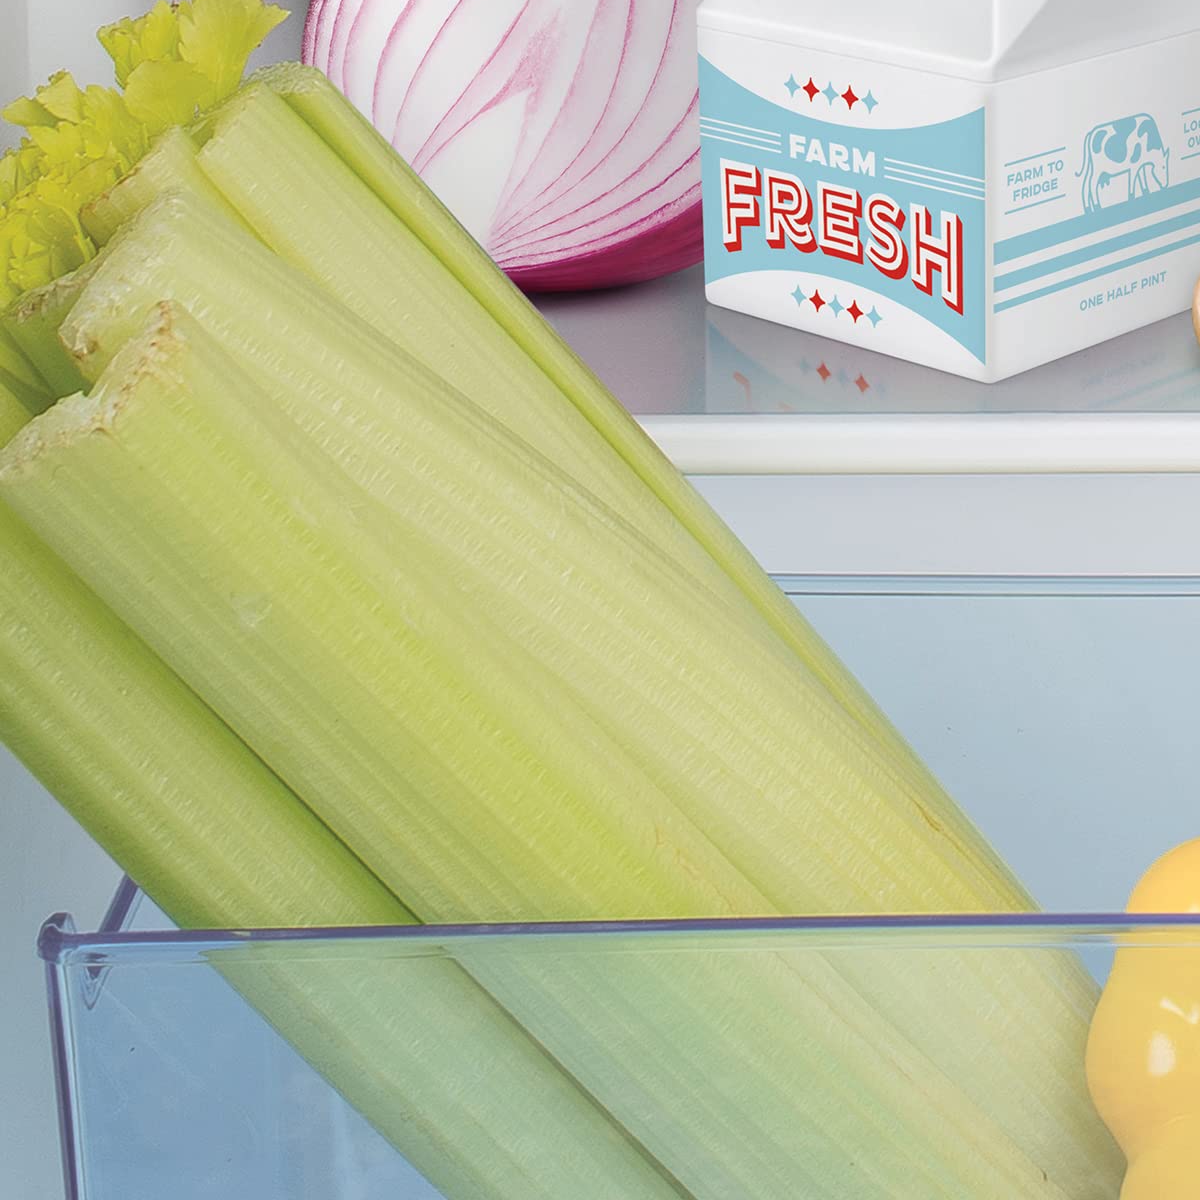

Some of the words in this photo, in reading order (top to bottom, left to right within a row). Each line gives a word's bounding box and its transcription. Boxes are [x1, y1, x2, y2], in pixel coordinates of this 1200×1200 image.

[788, 134, 876, 177] FARM
[1007, 164, 1043, 187] FARM
[1047, 159, 1064, 174] TO
[1012, 177, 1058, 202] FRIDGE
[718, 157, 965, 316] FRESH
[1079, 293, 1104, 311] ONE
[1106, 281, 1138, 302] HALF
[1140, 271, 1167, 289] PINT
